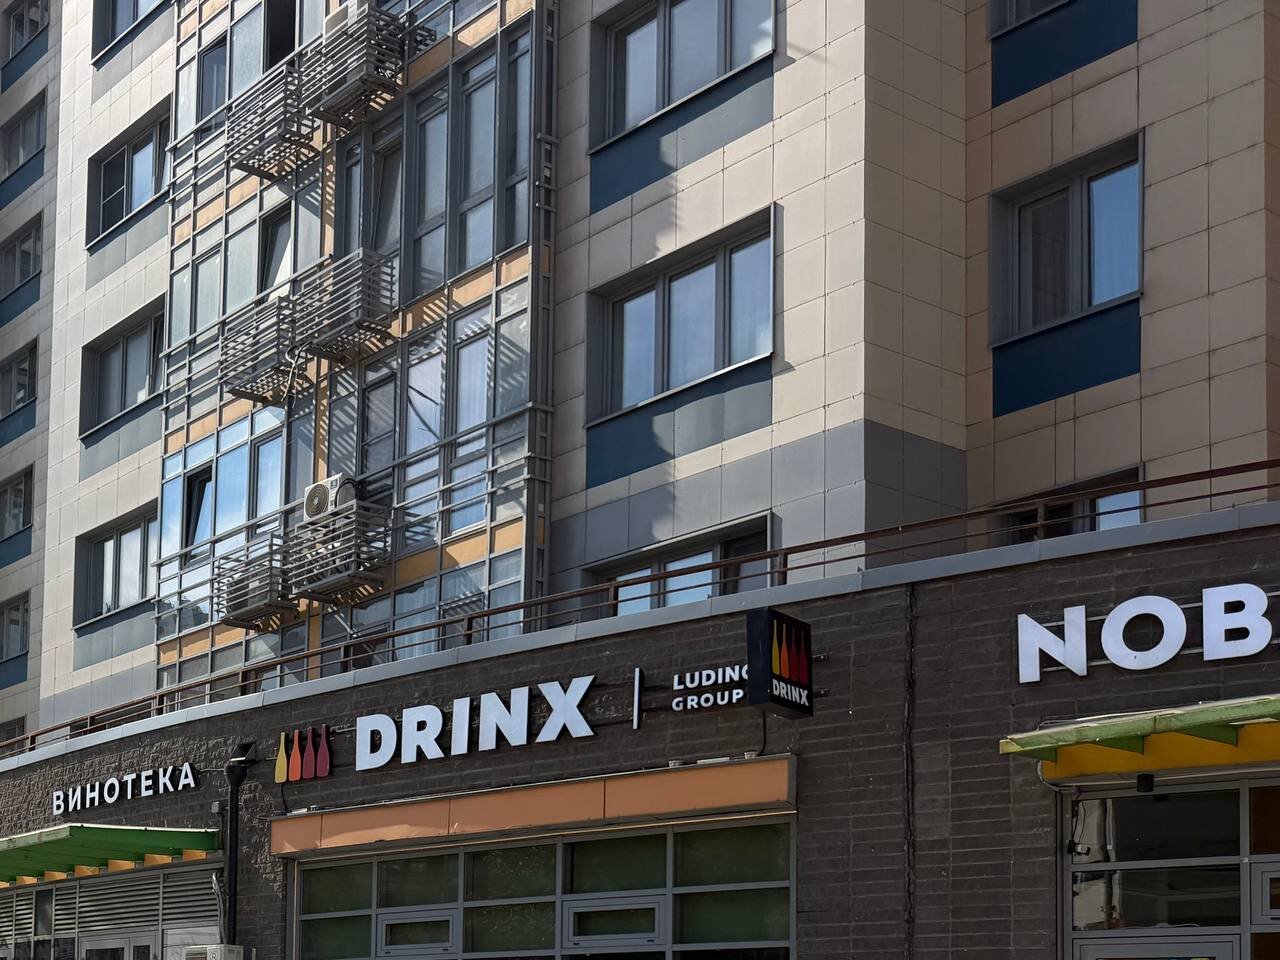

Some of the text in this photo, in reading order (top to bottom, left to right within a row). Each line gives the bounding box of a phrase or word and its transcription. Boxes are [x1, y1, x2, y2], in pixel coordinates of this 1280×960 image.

[1018, 583, 1273, 683] NOB
[672, 688, 744, 711] GROUP
[772, 679, 809, 706] DRINX
[355, 675, 595, 771] DRINX
[52, 762, 195, 816] ВИНОТЕКА
